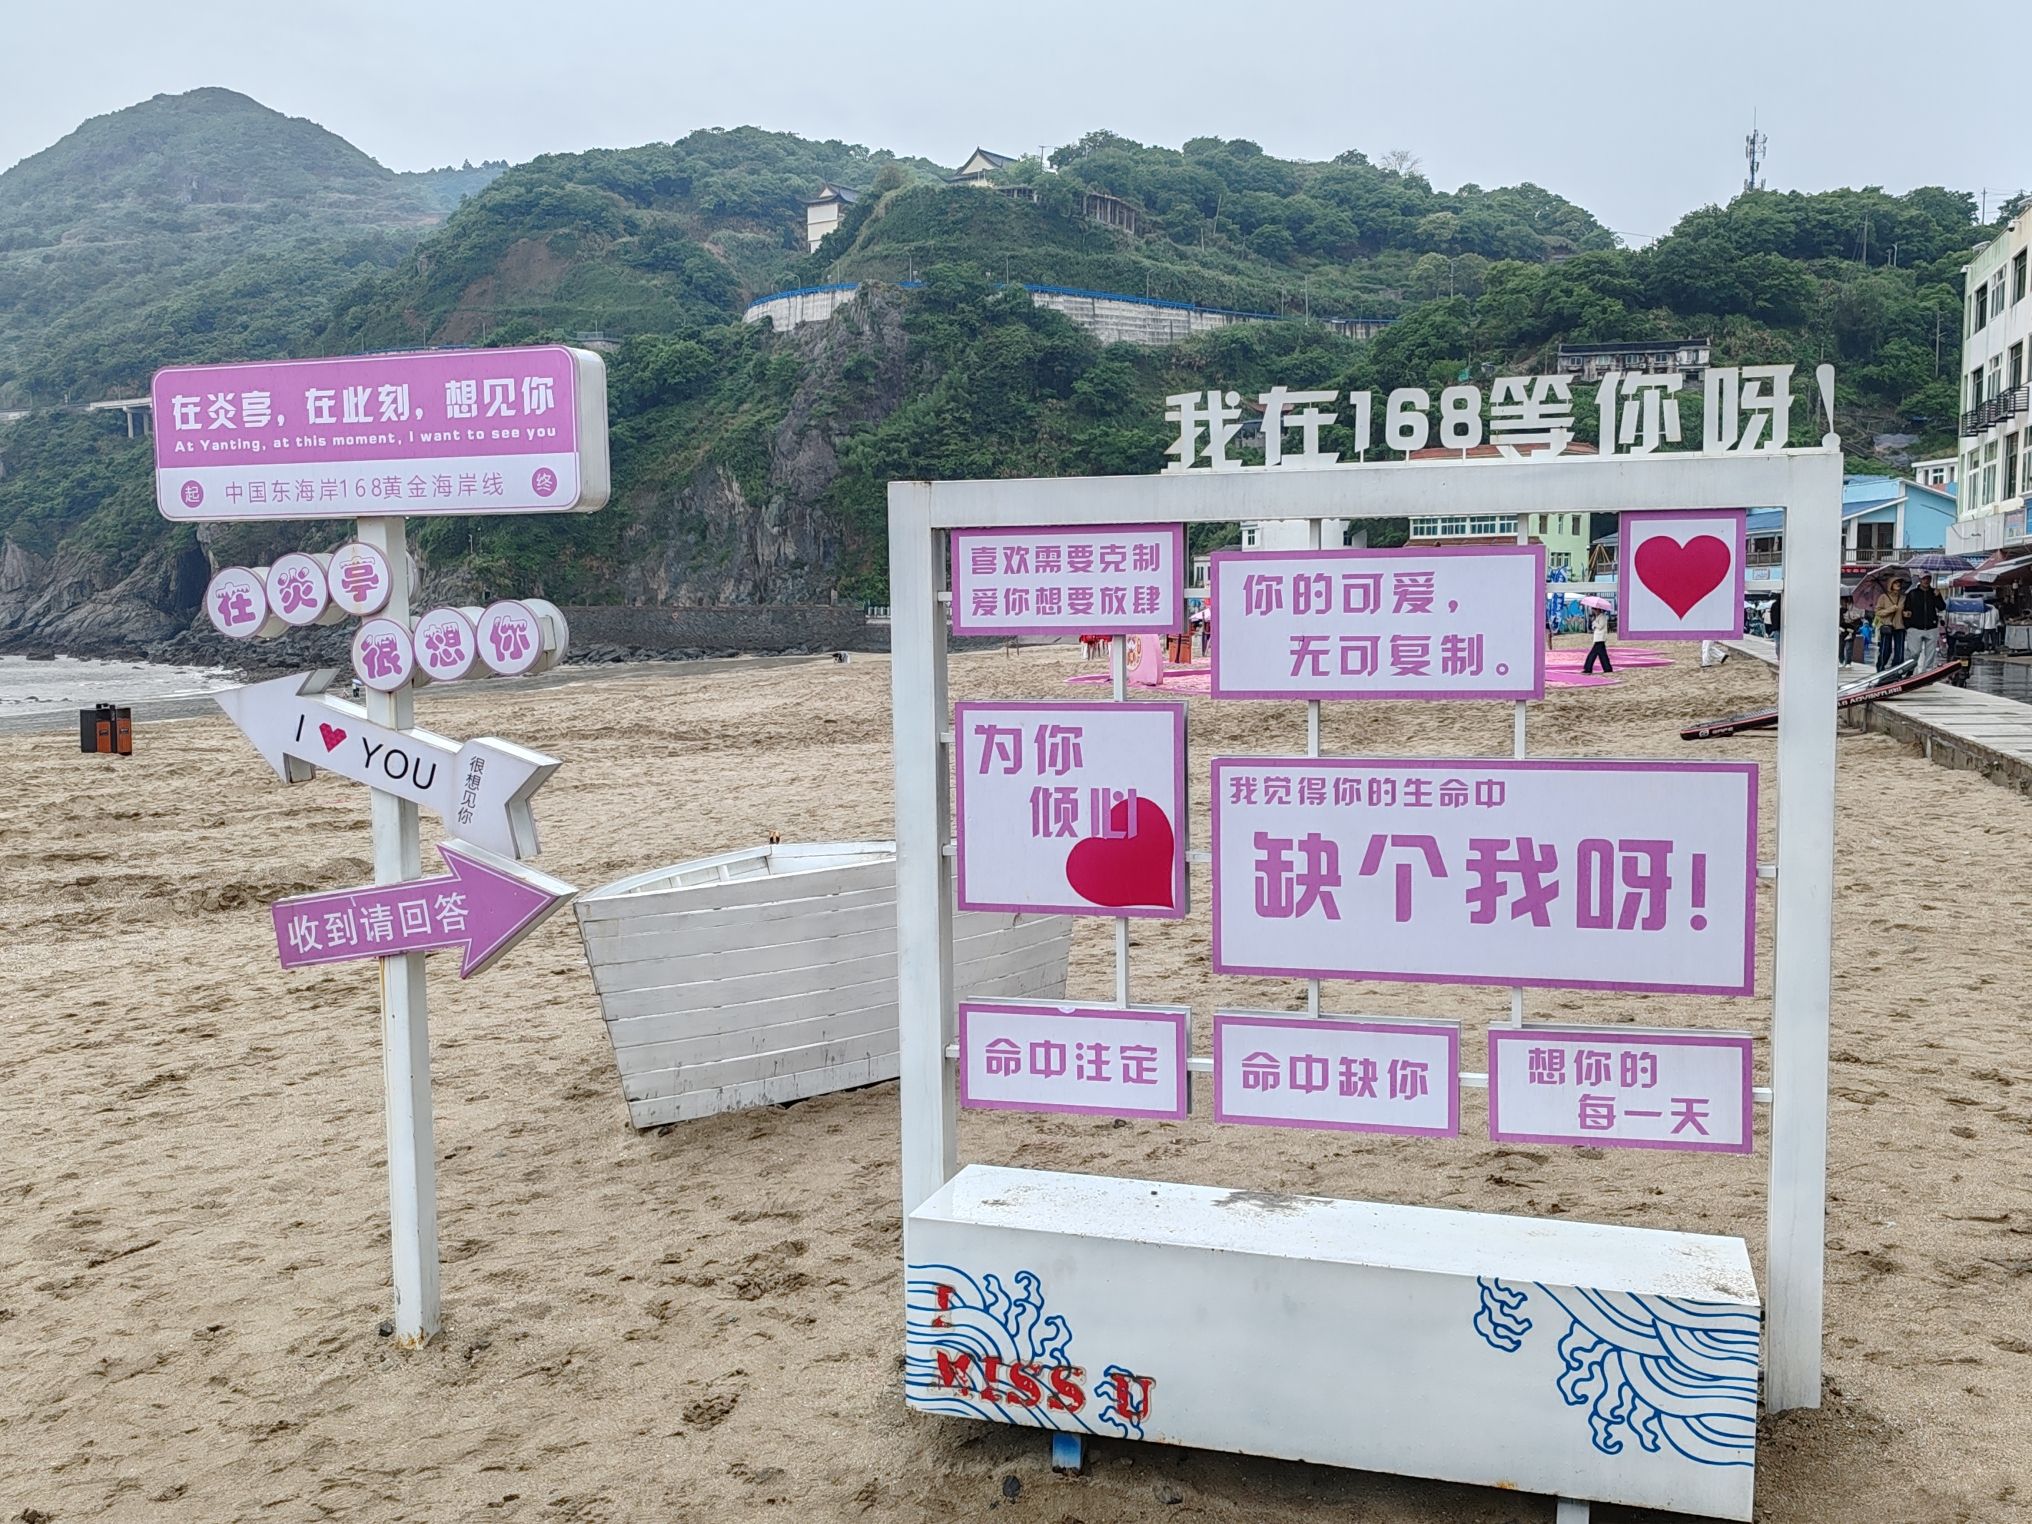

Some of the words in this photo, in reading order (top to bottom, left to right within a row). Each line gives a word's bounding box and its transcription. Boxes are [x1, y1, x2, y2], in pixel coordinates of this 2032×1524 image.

[175, 440, 194, 452] At
[200, 438, 267, 452] Yanting,
[273, 437, 290, 448] at
[296, 435, 327, 447] this
[332, 432, 402, 446] moment,
[409, 431, 414, 442] I
[420, 429, 461, 443] want
[467, 429, 485, 440] to
[492, 428, 520, 439] see
[527, 427, 556, 441] you
[185, 486, 200, 502] 起
[225, 472, 504, 504] 中国东海岸168黄金海岸线
[536, 473, 552, 491] 终
[970, 542, 1160, 575] 喜欢需要克制
[971, 585, 1161, 616] 爱你想要放肆
[1243, 571, 1459, 616] 你的可爱，
[1289, 634, 1509, 677] 无可复制。
[295, 714, 305, 742] I
[362, 736, 437, 790] YOU
[974, 724, 1084, 776] 为你
[456, 755, 485, 825] 很想见你
[1229, 775, 1507, 809] 我觉得你的生命中
[1029, 786, 1138, 840] 倾心
[1253, 831, 1708, 931] 缺个我呀！
[287, 892, 470, 954] 收到请回答
[985, 1037, 1159, 1085] 命中注定
[1241, 1051, 1429, 1100] 命中缺你
[1528, 1047, 1658, 1089] 想你的
[1578, 1094, 1711, 1136] 每一天
[1110, 1372, 1157, 1422] U
